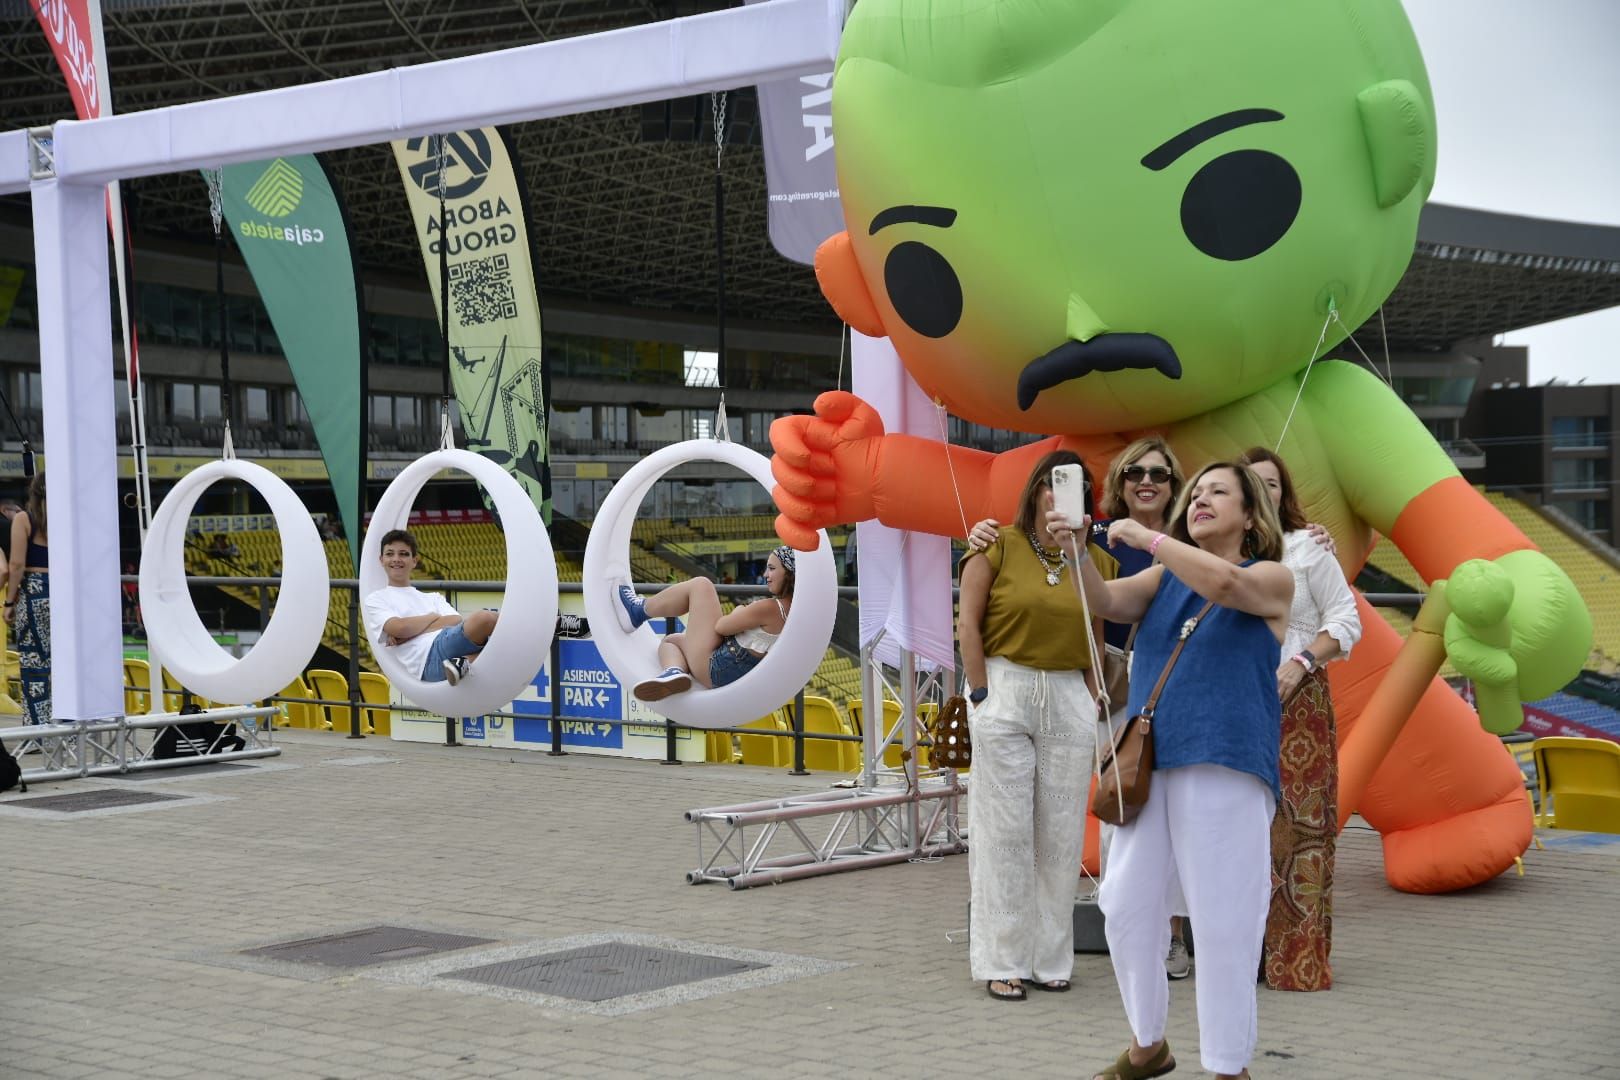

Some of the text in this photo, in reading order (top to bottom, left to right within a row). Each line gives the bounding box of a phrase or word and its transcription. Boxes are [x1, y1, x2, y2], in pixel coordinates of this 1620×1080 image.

[563, 669, 611, 683] ASIENTOS
[564, 687, 594, 707] PAR
[547, 717, 596, 736] IPAR
